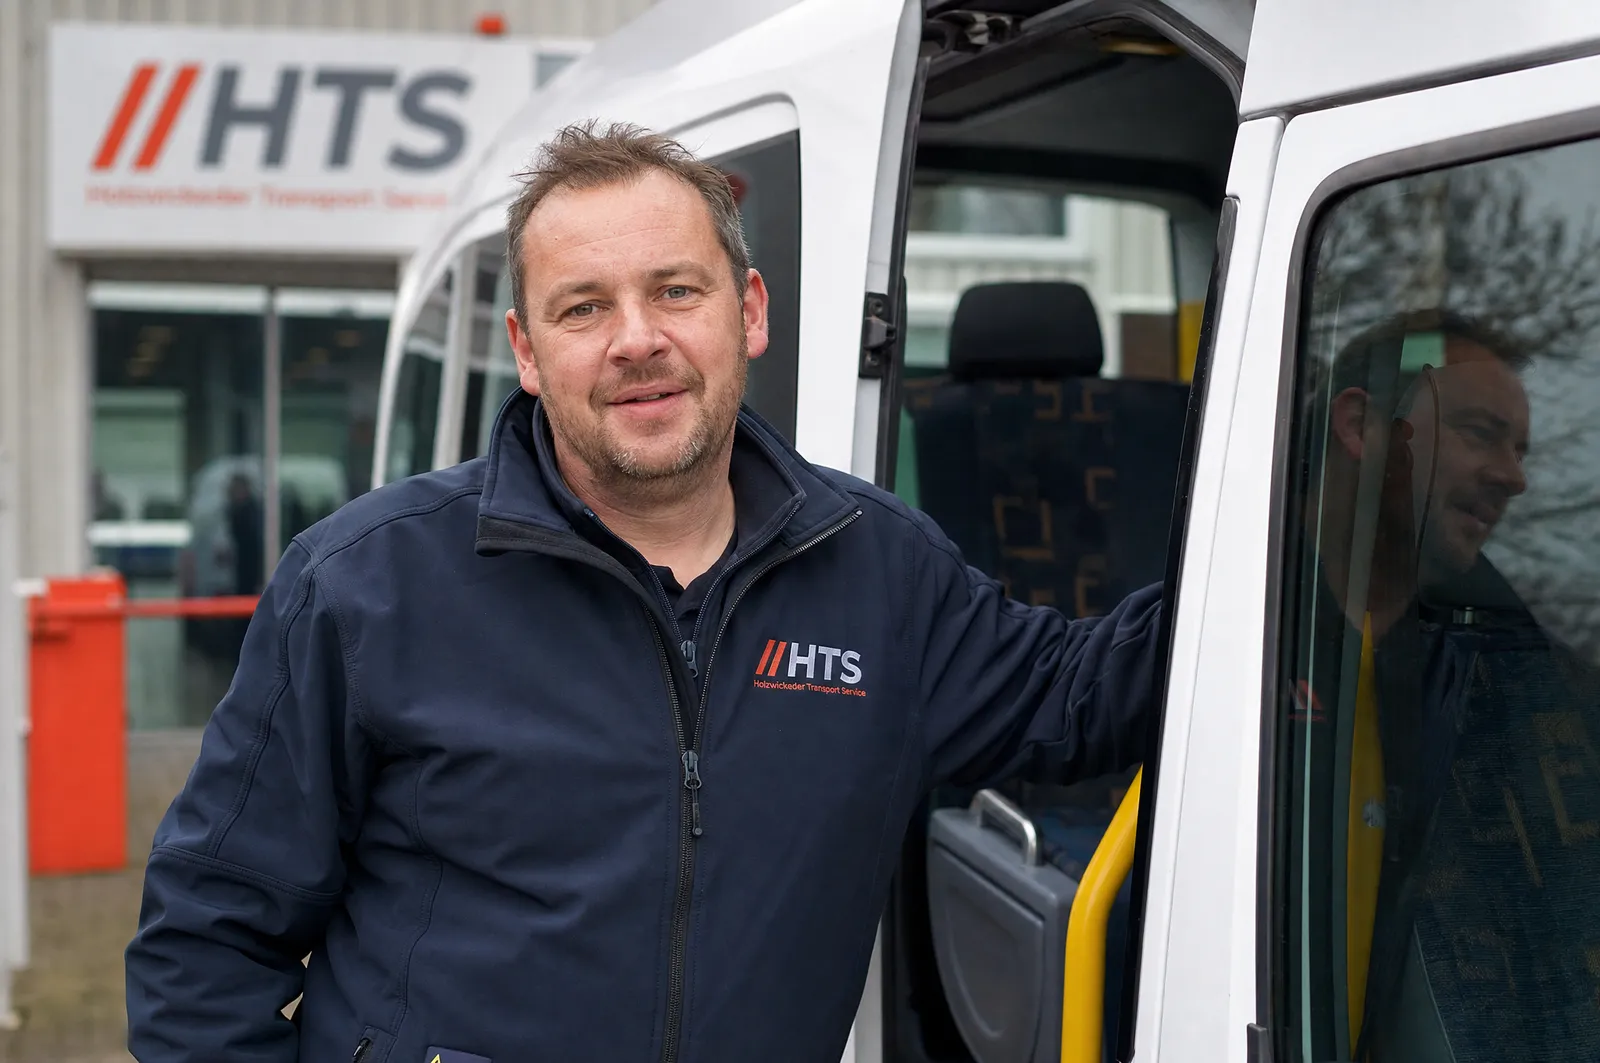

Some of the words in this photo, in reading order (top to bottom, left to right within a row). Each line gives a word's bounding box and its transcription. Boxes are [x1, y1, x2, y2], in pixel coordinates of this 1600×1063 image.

[202, 65, 472, 172] HTS
[787, 642, 863, 685] HTS
[753, 680, 805, 691] Holzwickeder
[806, 683, 841, 695] Transport
[841, 686, 867, 697] Service
